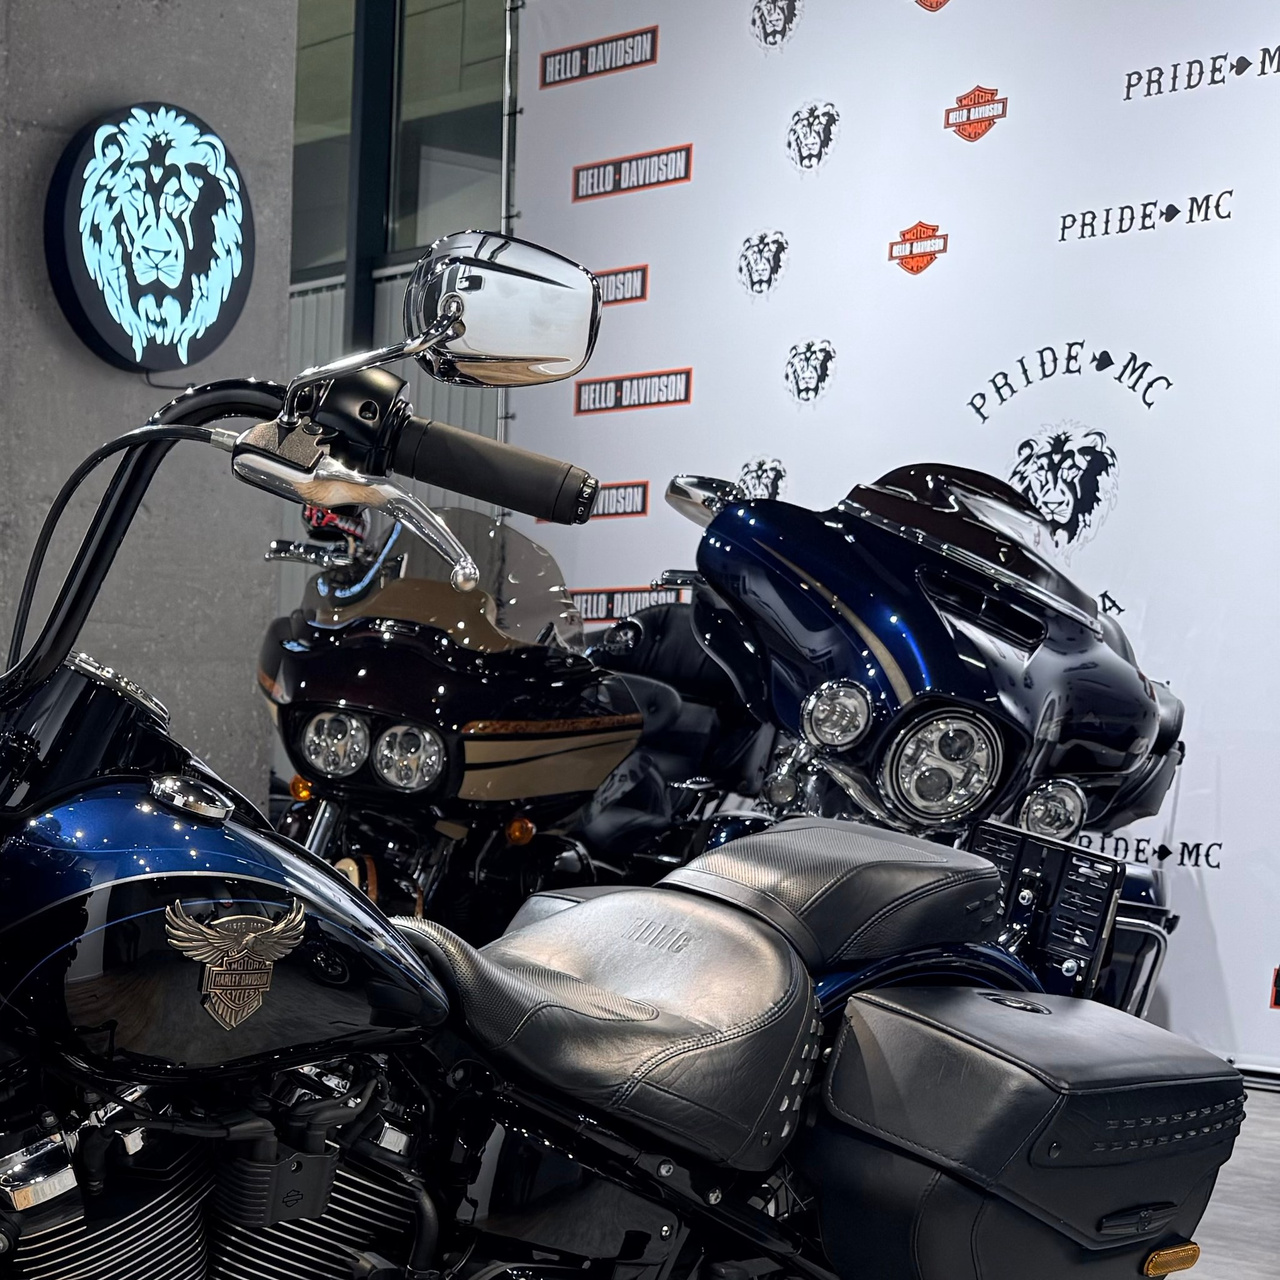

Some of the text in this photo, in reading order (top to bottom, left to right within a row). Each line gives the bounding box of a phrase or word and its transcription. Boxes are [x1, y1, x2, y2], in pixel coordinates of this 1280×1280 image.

[545, 33, 652, 83] HELLO DAVIDSON
[1123, 45, 1280, 101] PRIDE M
[578, 150, 687, 197] HELLO DAVIDSON
[1058, 189, 1234, 242] PRIDE MC
[580, 373, 687, 411] HELLO DAVIDSON
[966, 339, 1174, 424] PRIDE MC
[593, 486, 643, 514] VIDSON
[1078, 833, 1223, 869] RIDE MC
